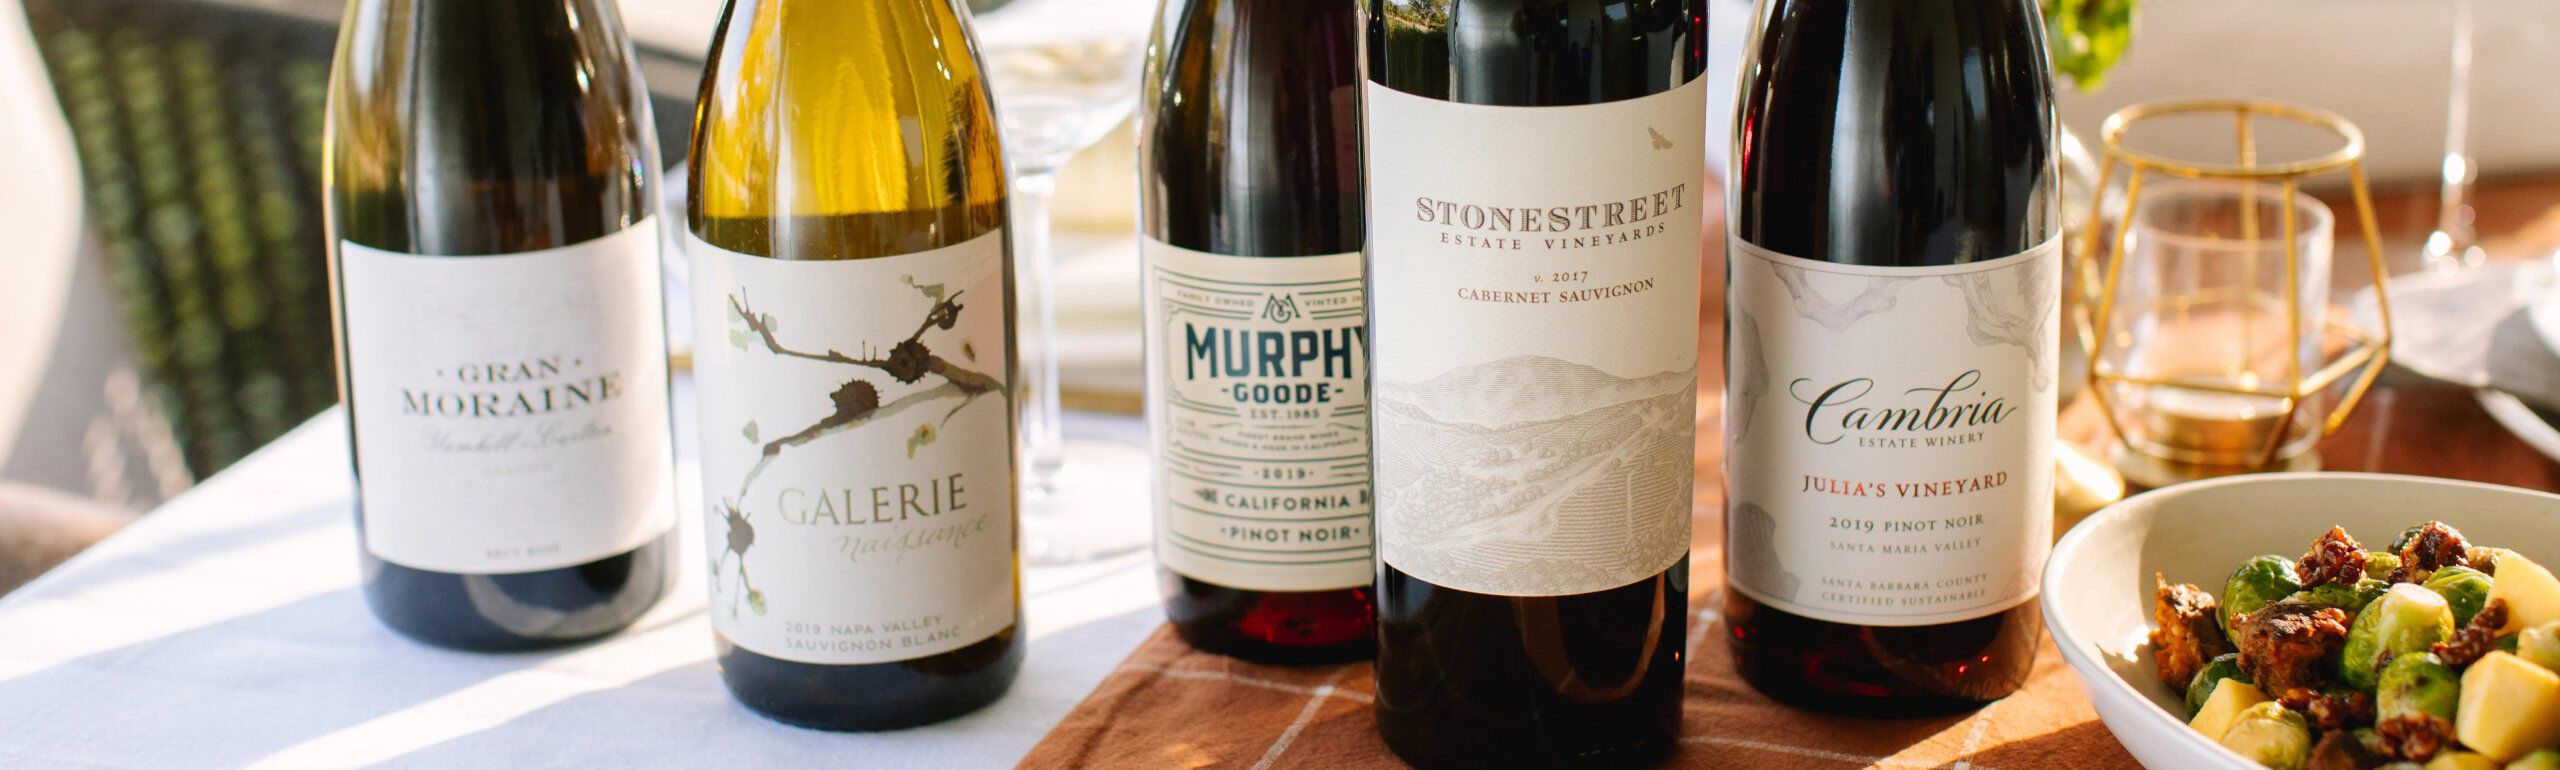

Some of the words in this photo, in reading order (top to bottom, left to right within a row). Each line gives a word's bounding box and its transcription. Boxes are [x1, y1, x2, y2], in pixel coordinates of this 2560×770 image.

[1416, 182, 1686, 233] STONESTREET
[1441, 232, 1522, 250] ESTATE
[1545, 221, 1666, 250] VINEYARDS
[1552, 270, 1589, 283] 2017
[1304, 295, 1348, 307] VINTED
[1458, 287, 1551, 304] CABERNET
[1558, 277, 1655, 303] SAUVIGNON
[457, 355, 563, 386] GRAN
[401, 371, 623, 419] MORAINE
[1790, 369, 2018, 445] Cambria
[1859, 437, 1917, 448] ESTATE
[1925, 431, 1986, 448] WINERY
[1802, 475, 1886, 498] JULIA'S
[1895, 471, 2009, 498] VINEYARD
[777, 473, 968, 526] GALERIE
[1225, 493, 1351, 512] CALIFORNIA
[1229, 526, 1291, 543] PINOT
[1299, 526, 1352, 543] NOIR
[1829, 516, 1875, 533] 2019
[1883, 519, 1938, 532] PINOT
[1945, 514, 1985, 529] NOIR
[830, 513, 988, 564] naissance
[1829, 540, 1875, 554] SANTA
[1882, 544, 1928, 555] MARIA
[1934, 537, 1981, 552] VALLEY
[1820, 576, 1863, 590] SANTA
[1869, 581, 1930, 591] BARBARA
[1936, 573, 1988, 588] COUNTY
[1820, 591, 1895, 606] CERTIFIED
[1902, 588, 1987, 606] SUSTAINABLE
[785, 621, 822, 636] 2019
[830, 624, 875, 636] NAPA
[880, 614, 943, 633] VALLEY
[785, 637, 892, 654] SAUVIGNON
[901, 625, 961, 648] BLANC
